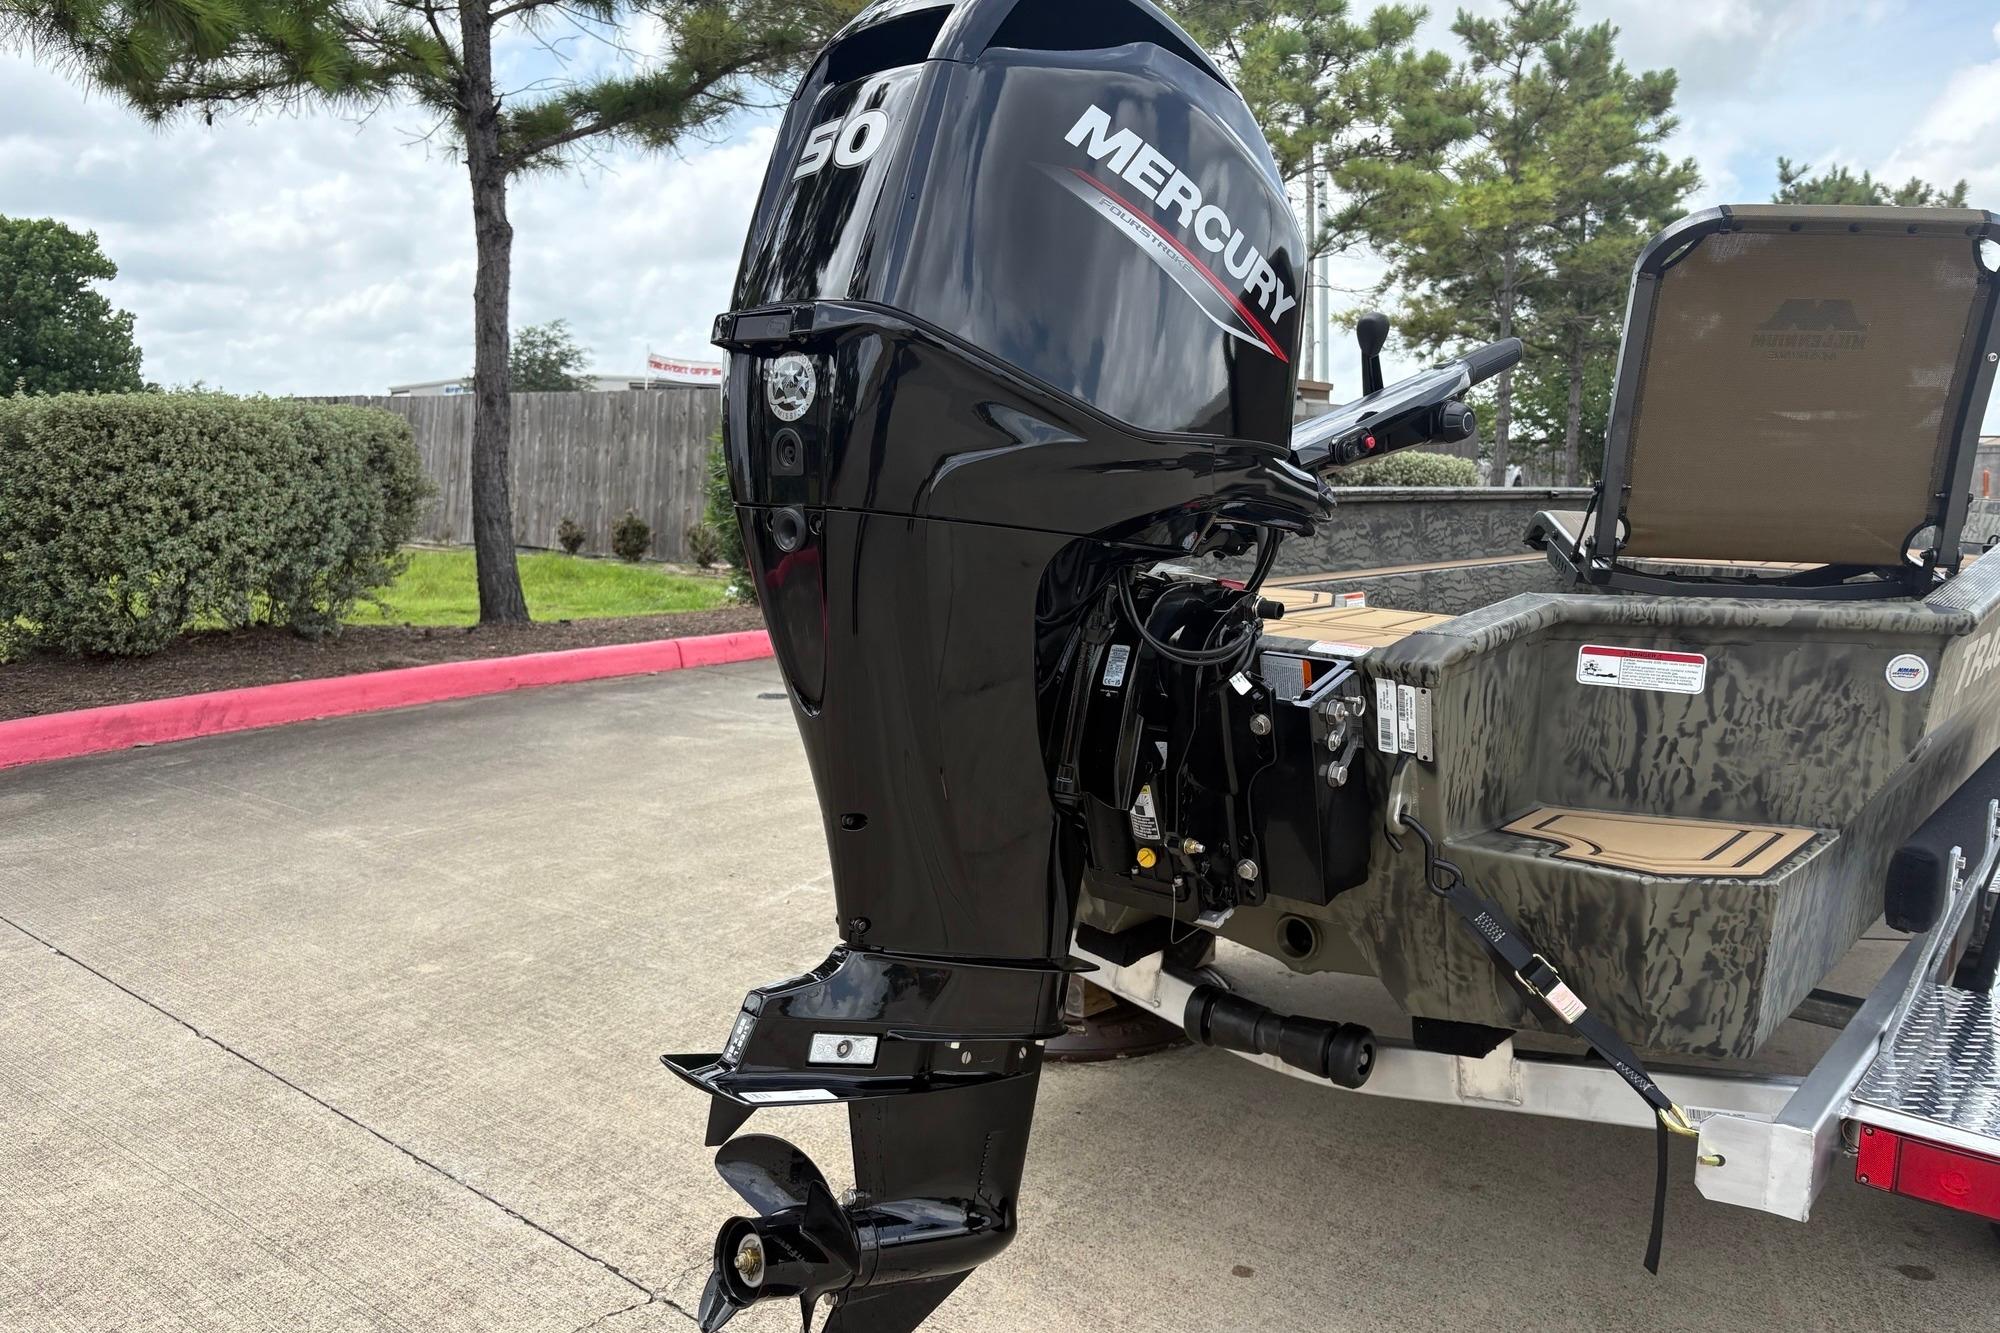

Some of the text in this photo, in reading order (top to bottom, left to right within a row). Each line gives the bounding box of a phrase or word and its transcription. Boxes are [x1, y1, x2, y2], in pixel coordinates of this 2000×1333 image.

[793, 108, 890, 183] 50
[1064, 104, 1297, 325] MERCURY
[1098, 195, 1195, 272] FOURSTROKE
